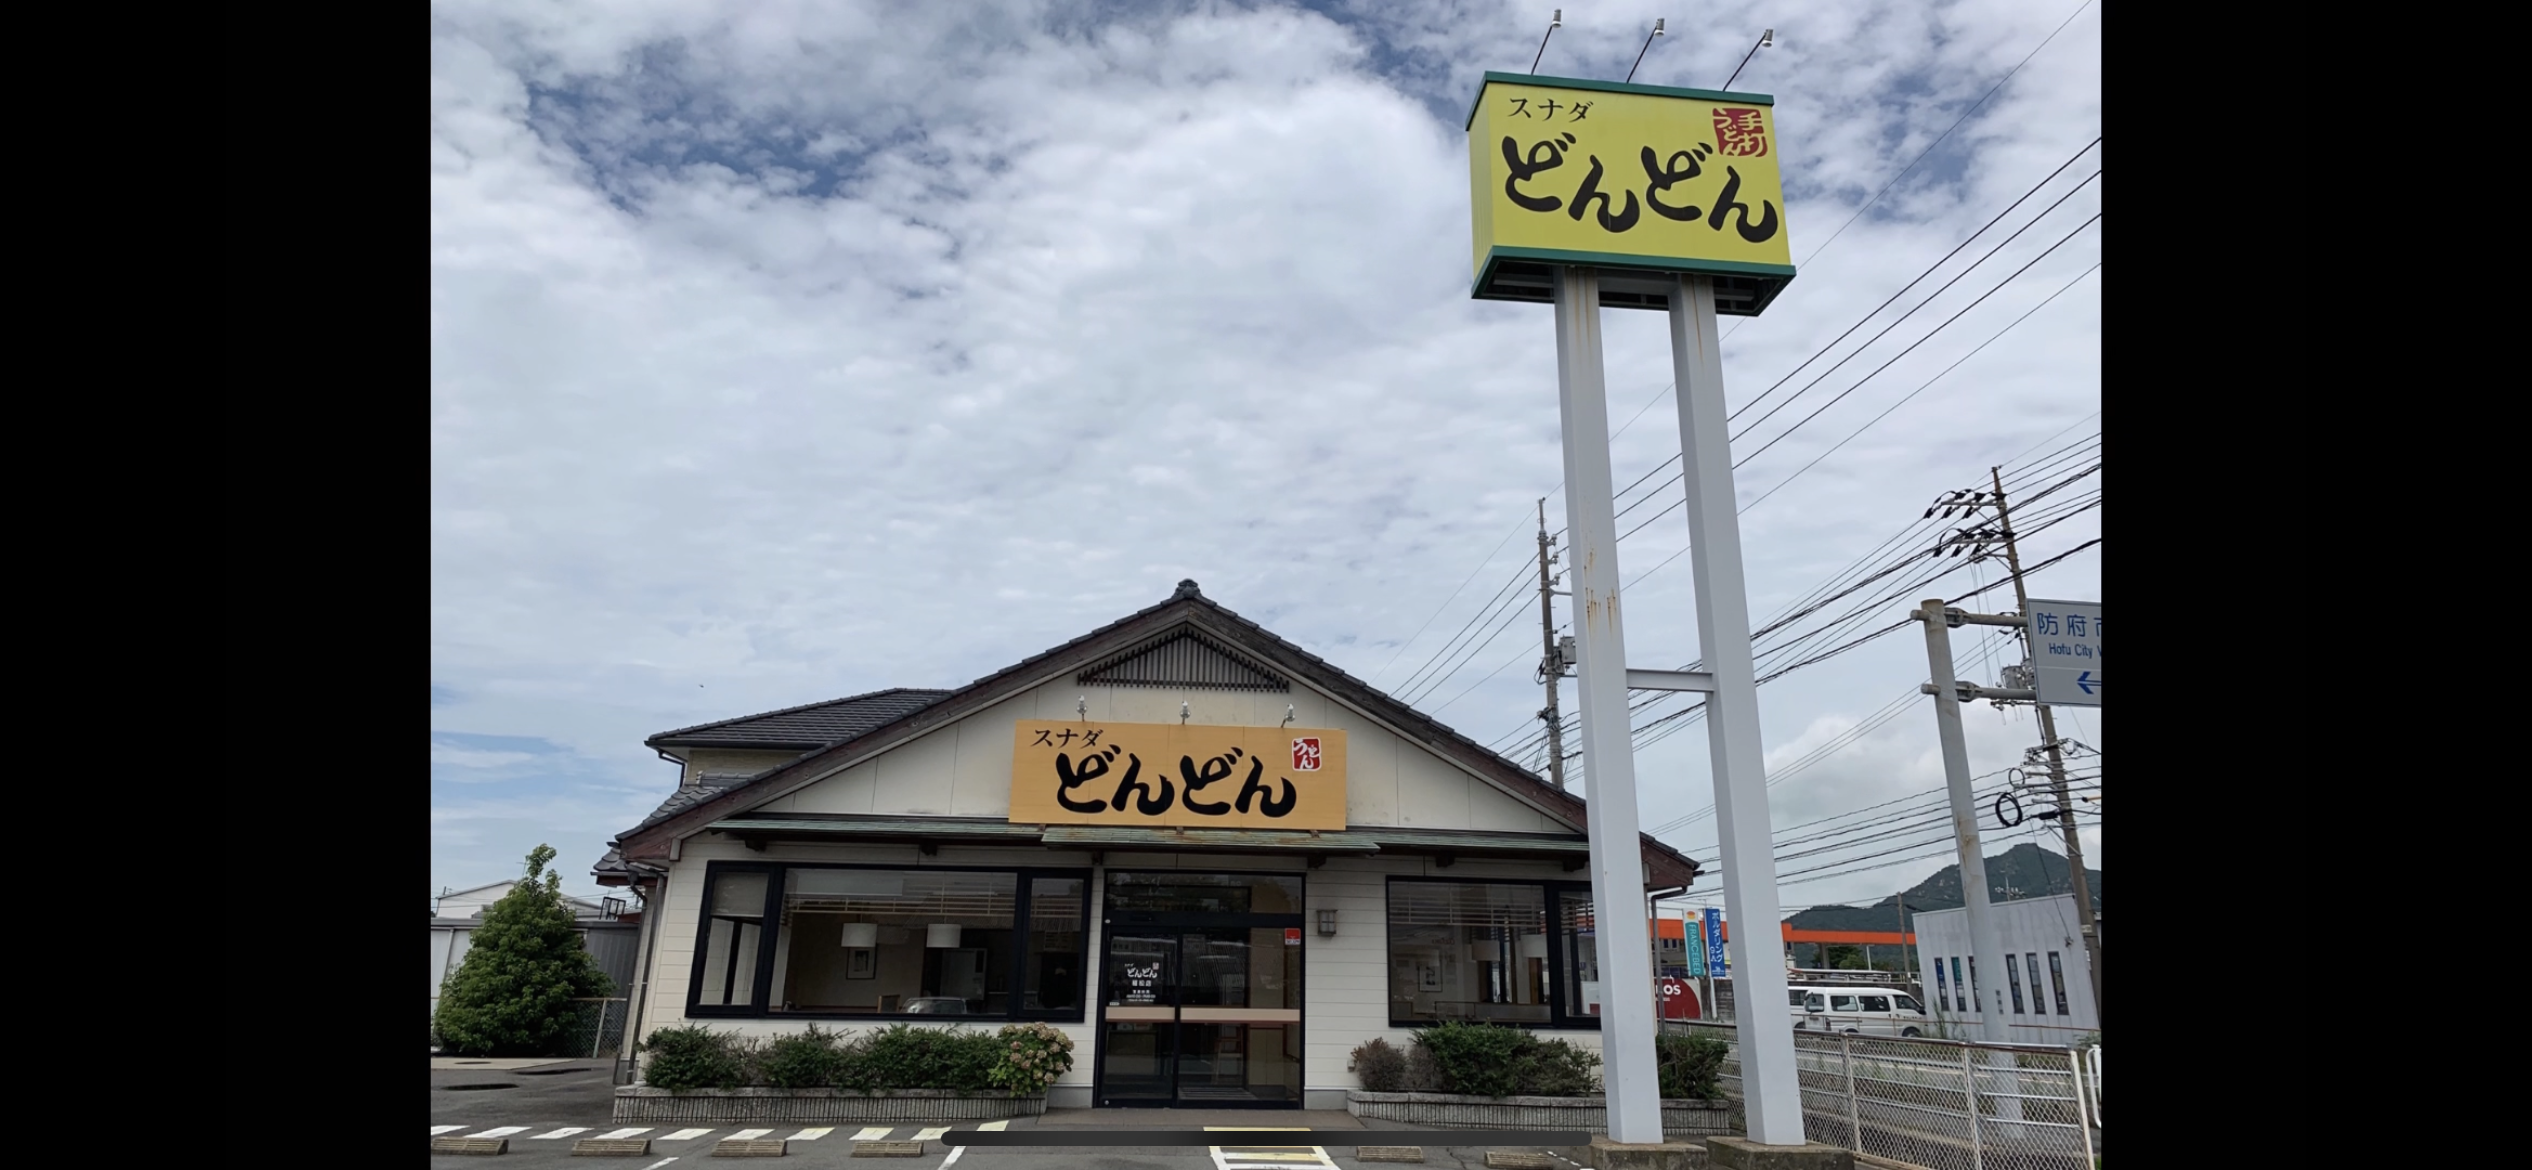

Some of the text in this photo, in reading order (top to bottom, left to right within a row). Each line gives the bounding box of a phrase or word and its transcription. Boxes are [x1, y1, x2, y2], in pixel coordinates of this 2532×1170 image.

[1508, 97, 1594, 122] スナダ
[1501, 132, 1779, 243] どんどん
[2049, 643, 2071, 655] Hofu
[2075, 643, 2093, 659] City
[1030, 728, 1104, 749] スナダ
[1056, 744, 1297, 818] どんどん
[1689, 924, 1701, 975] FRANCEBED
